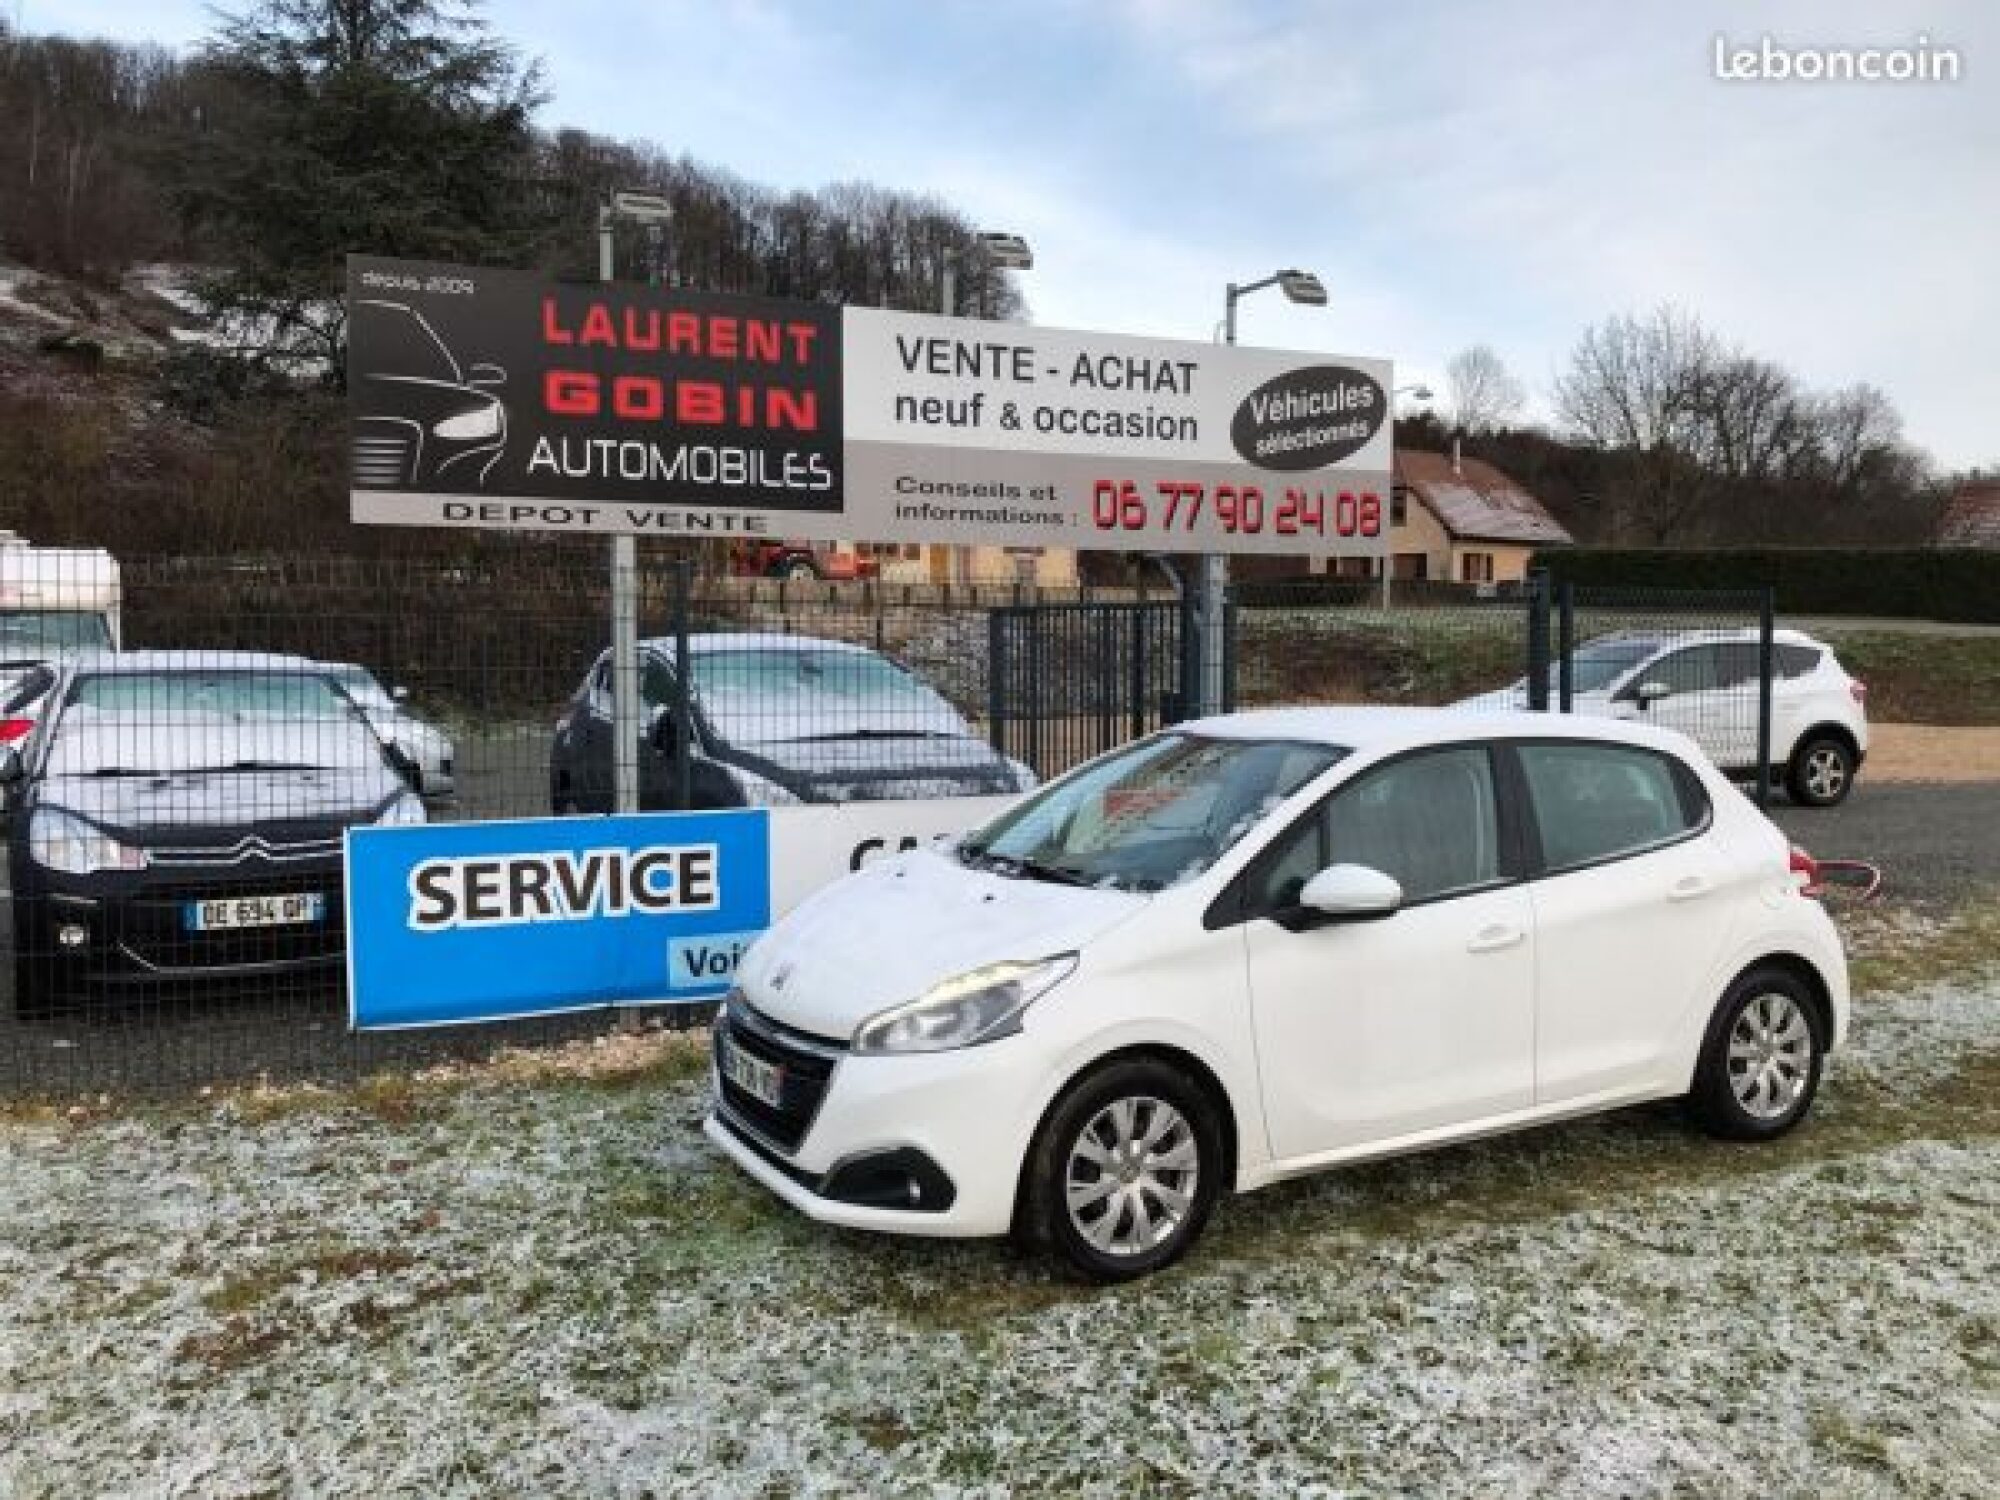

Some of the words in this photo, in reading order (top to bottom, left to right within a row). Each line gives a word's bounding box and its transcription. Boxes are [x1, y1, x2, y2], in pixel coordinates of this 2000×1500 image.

[541, 299, 819, 366] LAURENT
[895, 334, 1036, 382] VENTE
[1070, 353, 1199, 396] ACHAT
[542, 370, 819, 431] GOBIN
[894, 394, 985, 428] neuf
[999, 402, 1023, 431] &
[1034, 402, 1199, 442] occasion
[526, 435, 833, 491] AUTOMOBILES
[895, 475, 1022, 498] Conseils
[1029, 482, 1058, 501] et
[443, 502, 600, 525] DEPOT
[627, 508, 769, 532] VENTE
[1093, 479, 1148, 531] 06
[1155, 483, 1204, 532] 77
[1212, 485, 1264, 534] 90
[1275, 489, 1324, 536] 24
[1335, 492, 1382, 537] 08
[415, 847, 714, 926] SERVICE
